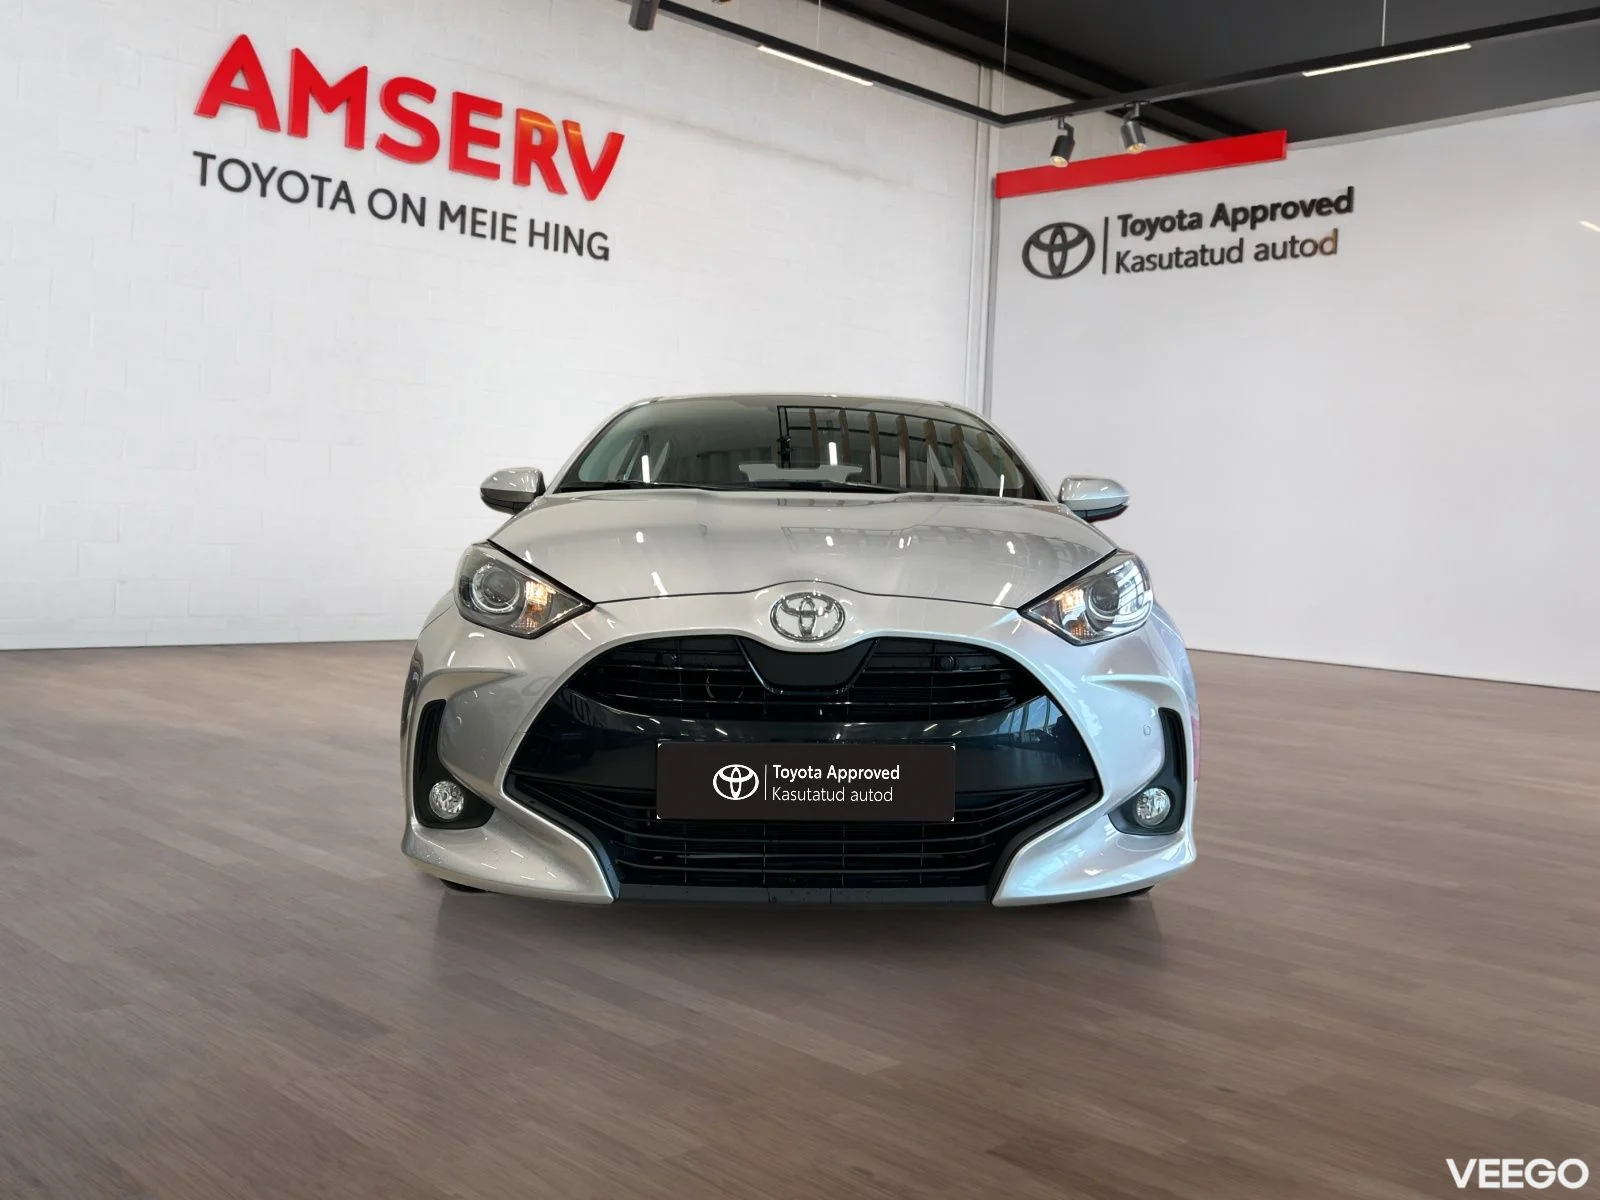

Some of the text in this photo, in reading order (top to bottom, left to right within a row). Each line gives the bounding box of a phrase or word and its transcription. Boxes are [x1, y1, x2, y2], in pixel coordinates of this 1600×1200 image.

[194, 34, 625, 201] AMSERV
[192, 151, 611, 261] TOYOTA ON MEIE HING
[1117, 186, 1355, 241] Toyota Approved
[1115, 228, 1339, 274] Kasutatud autod
[772, 764, 900, 783] Toyota Approved
[772, 786, 893, 802] Kasutatud autod
